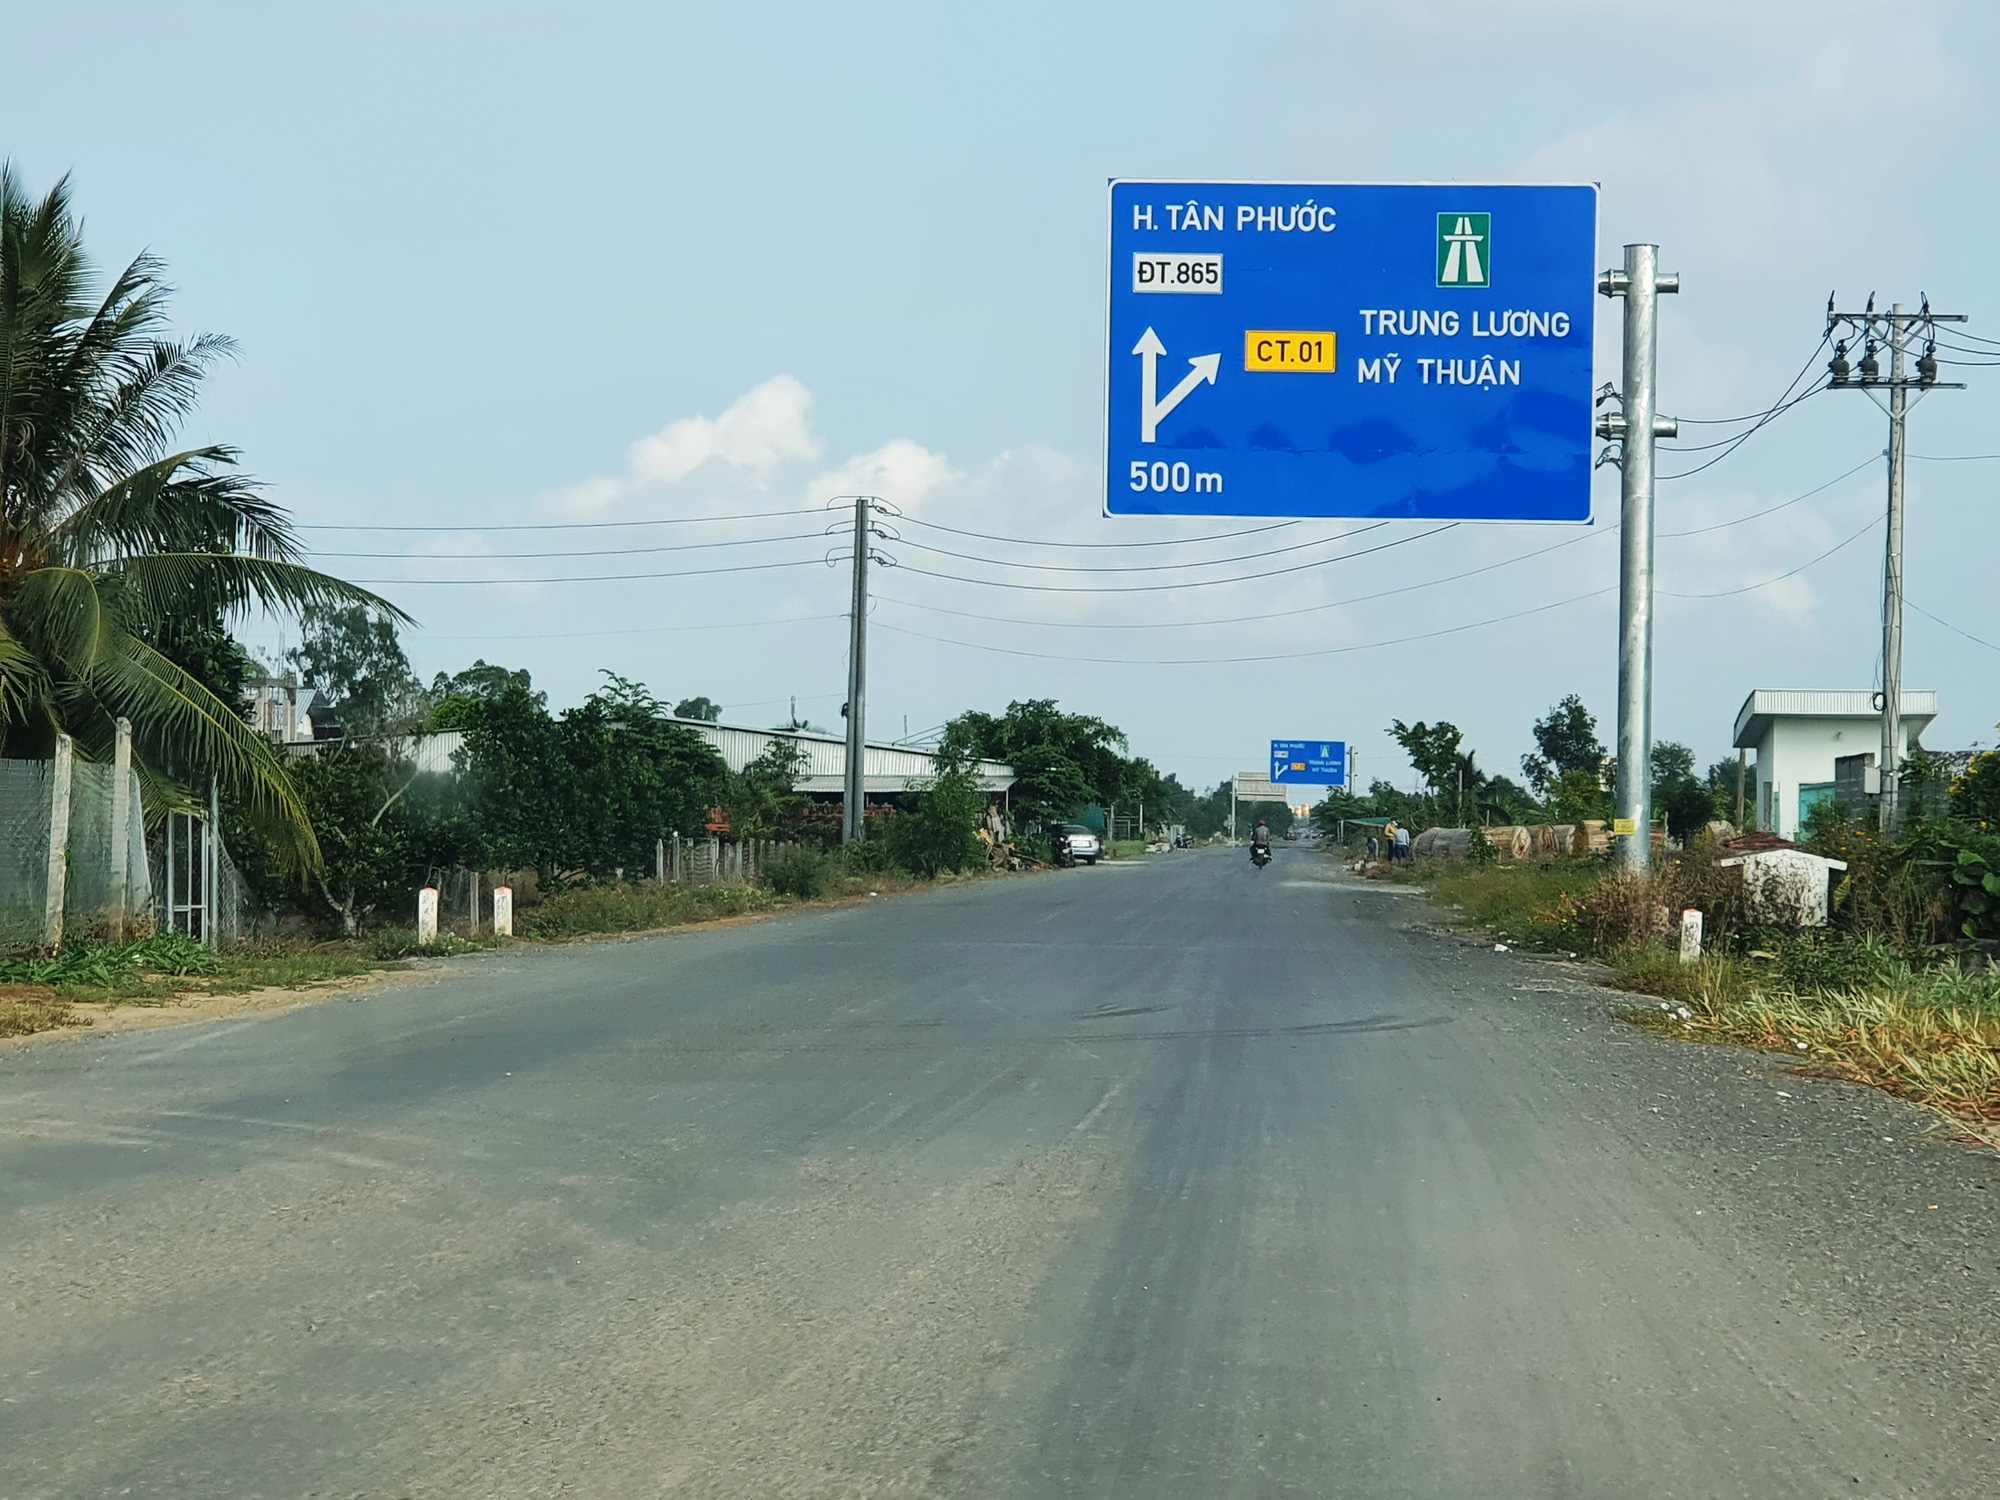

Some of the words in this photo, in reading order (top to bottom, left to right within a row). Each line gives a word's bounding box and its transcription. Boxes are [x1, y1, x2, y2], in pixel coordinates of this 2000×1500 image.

[1133, 204, 1159, 230] H.
[1166, 199, 1224, 231] TÂN
[1237, 199, 1336, 232] PHƯỚC
[1137, 261, 1218, 286] ĐT.865
[1359, 309, 1460, 338] TRUNG
[1472, 309, 1571, 338] LƯƠNG
[1257, 339, 1322, 363] CT.01
[1358, 352, 1402, 384] MỸ
[1417, 354, 1520, 391] THUẬN
